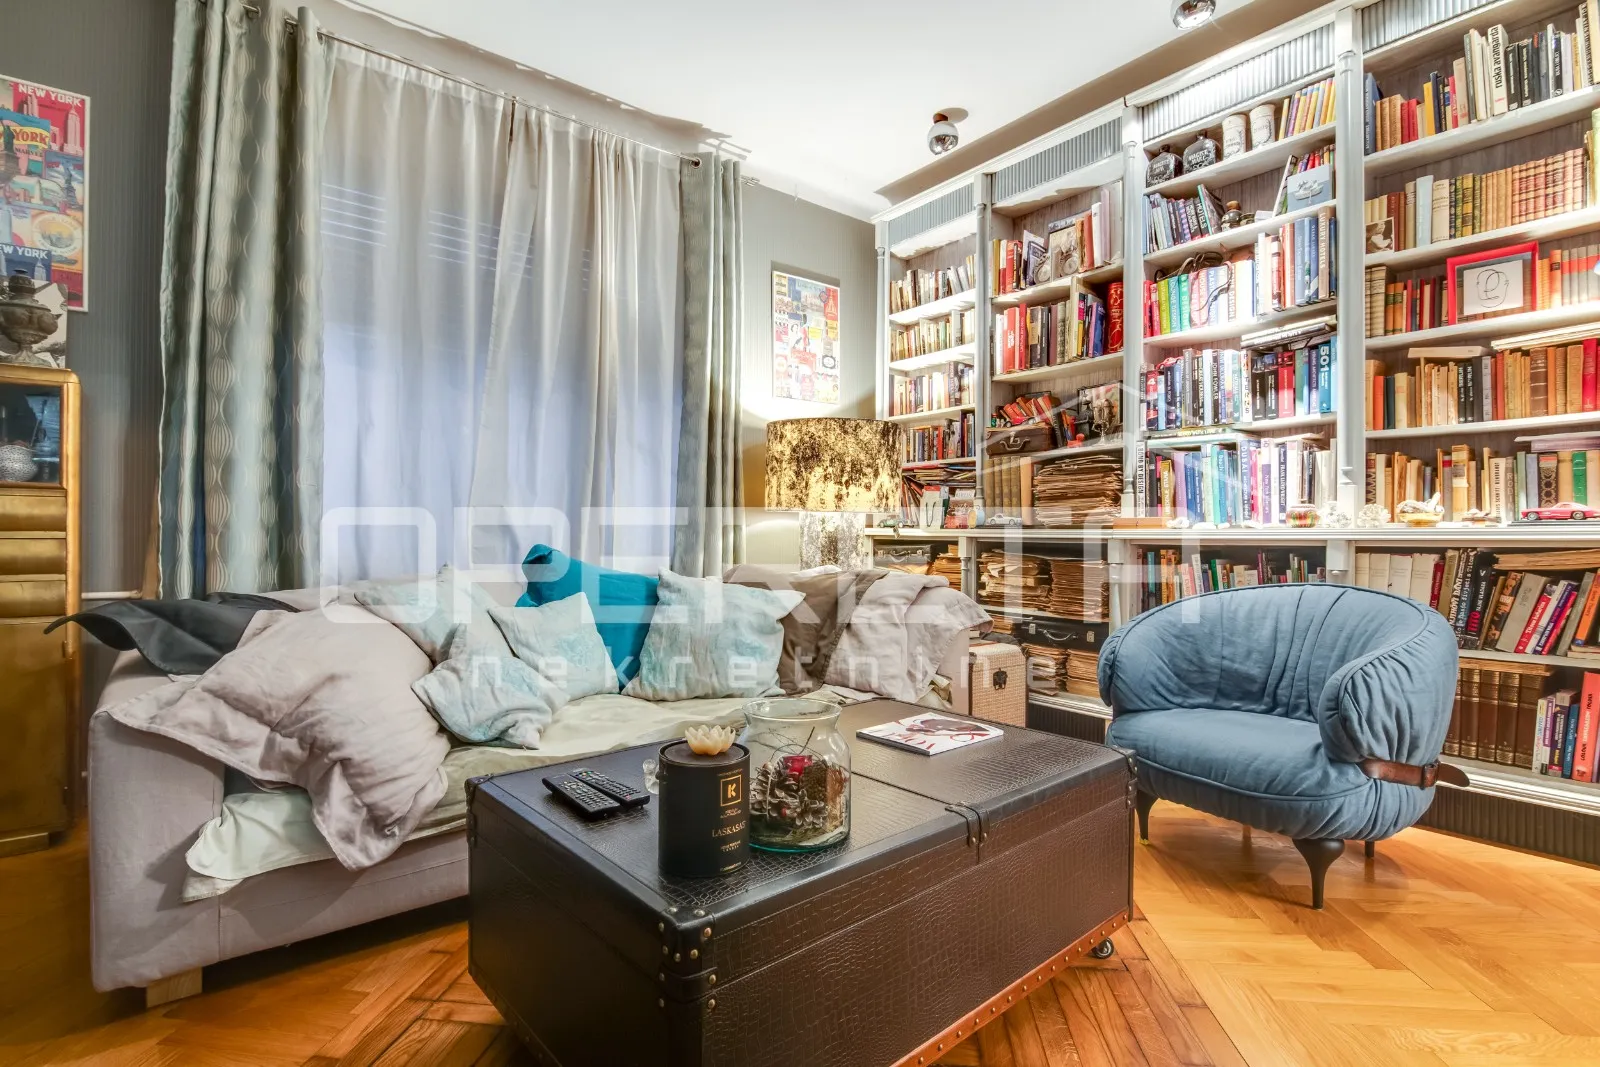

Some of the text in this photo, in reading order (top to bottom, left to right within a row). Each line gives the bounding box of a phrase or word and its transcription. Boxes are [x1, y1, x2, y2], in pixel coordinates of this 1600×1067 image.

[1489, 27, 1503, 89] ruska avangarda
[18, 83, 82, 107] NEW YORK
[12, 128, 48, 146] YORK
[1196, 202, 1207, 228] HOTELS
[16, 246, 48, 260] YORK
[1320, 346, 1329, 372] 501
[1138, 464, 1144, 472] BY
[1453, 578, 1463, 596] DANI
[727, 782, 737, 799] K
[712, 820, 746, 838] LASKASAS
